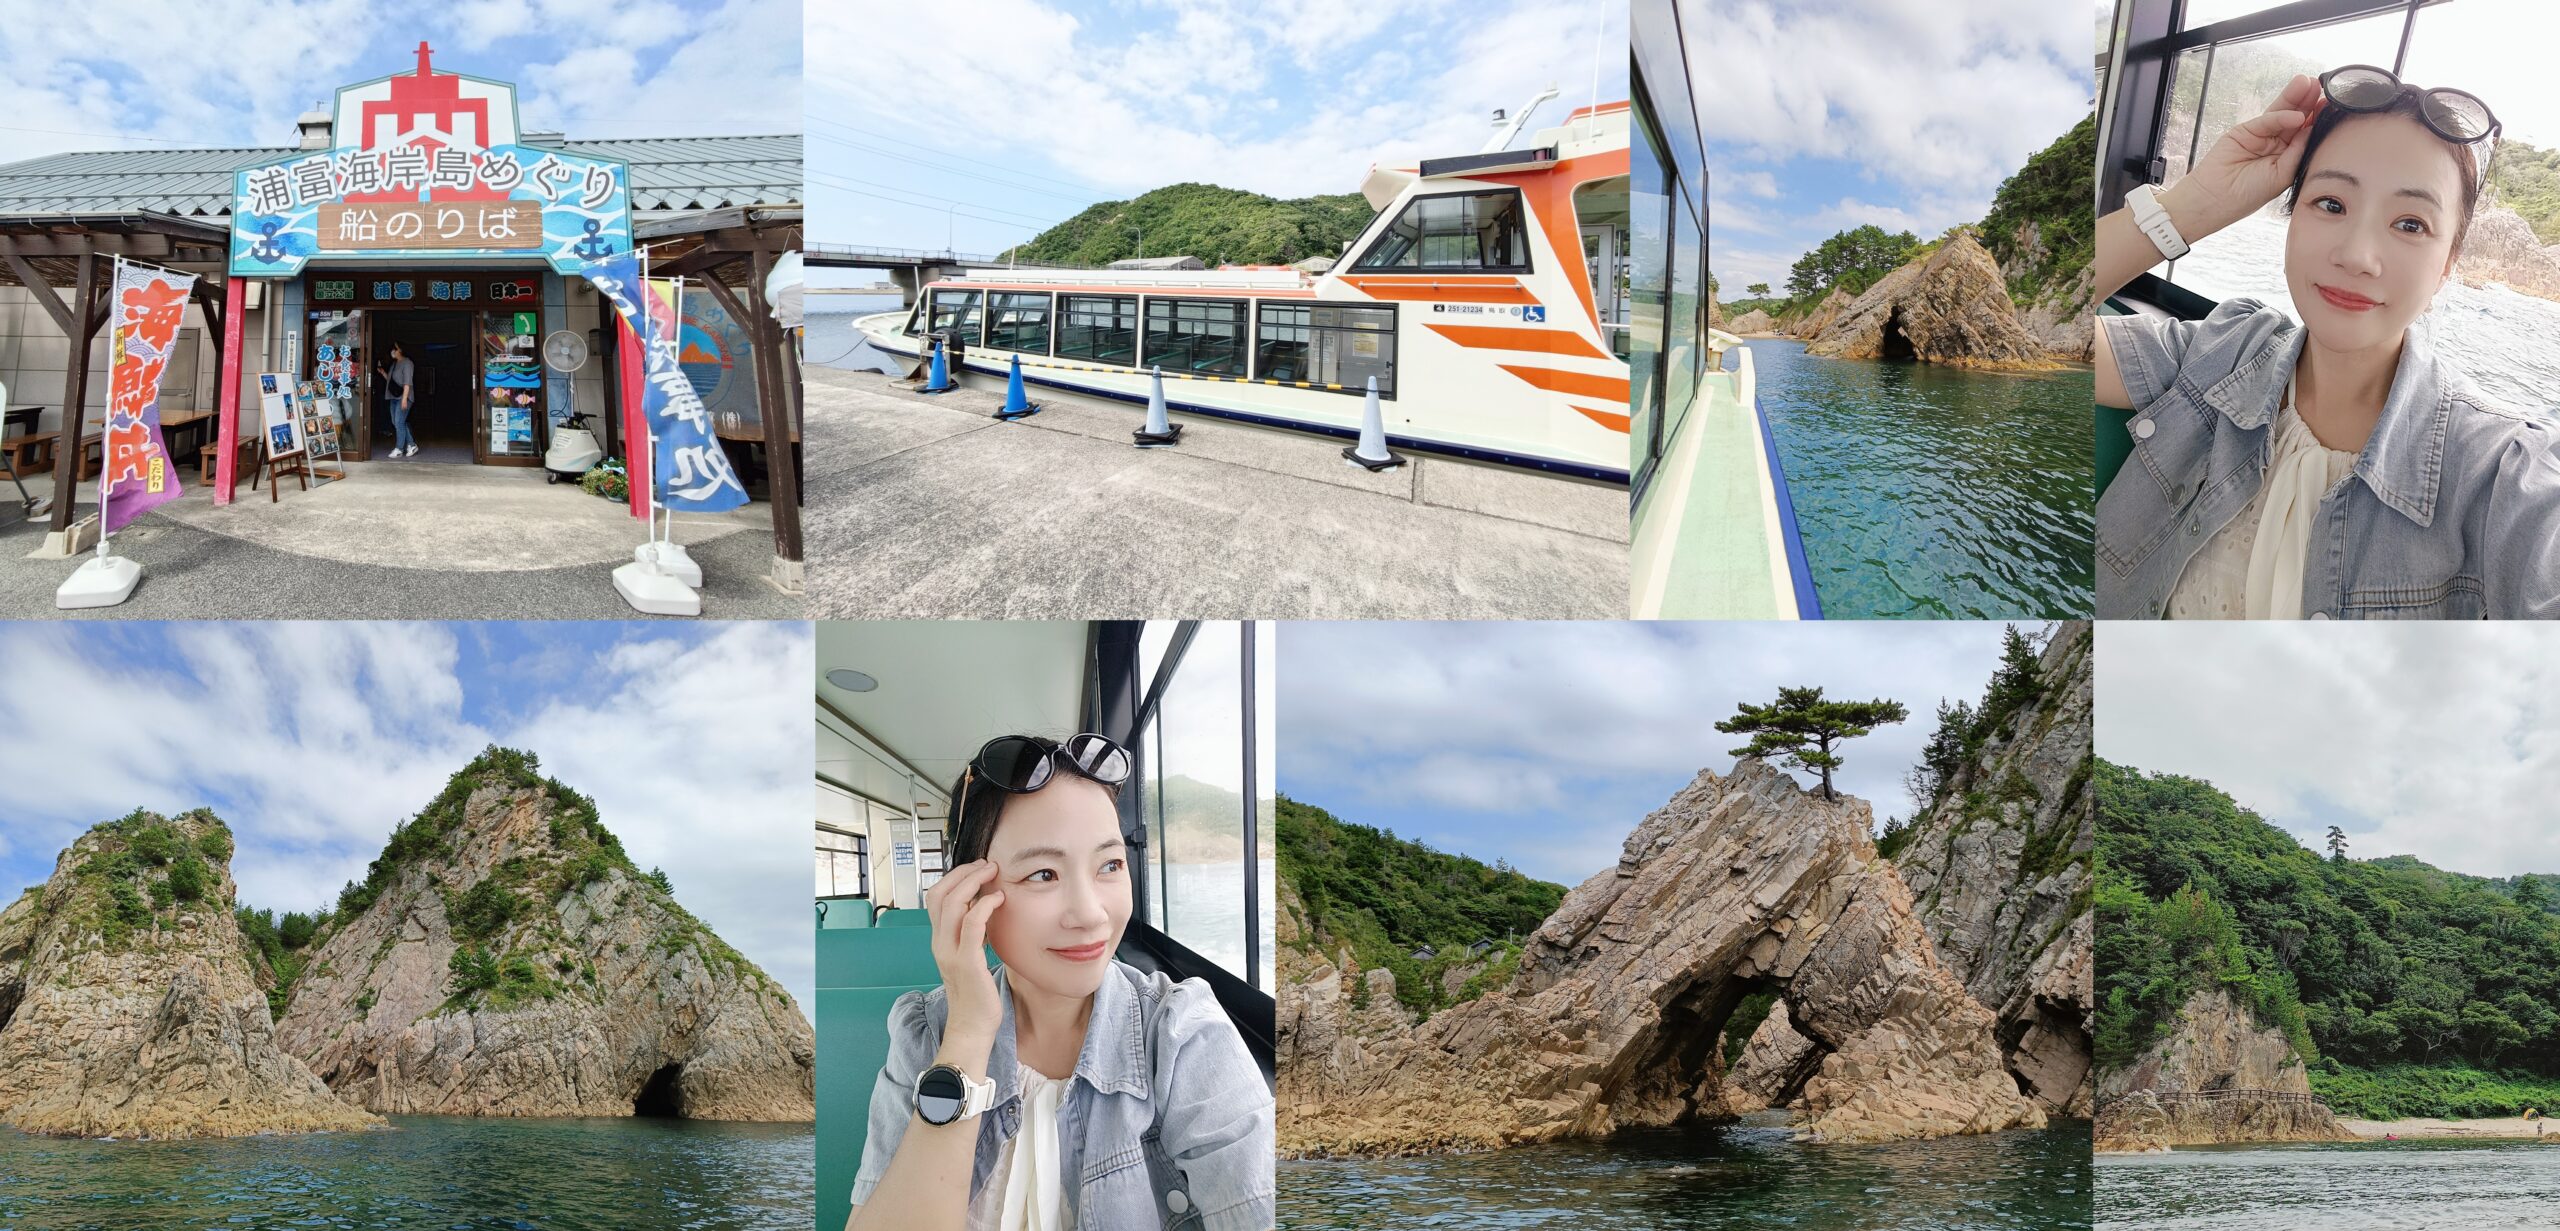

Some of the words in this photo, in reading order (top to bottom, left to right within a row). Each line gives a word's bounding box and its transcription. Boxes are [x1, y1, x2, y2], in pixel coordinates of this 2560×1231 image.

[248, 147, 616, 214] 浦富海岸島めぐり
[338, 207, 519, 242] 船のりば
[490, 282, 533, 300] 日本一
[1447, 304, 1484, 314] 251-21234
[107, 278, 191, 494] 海鮮丼
[338, 344, 353, 399] お食事処
[151, 459, 162, 490] こだわり
